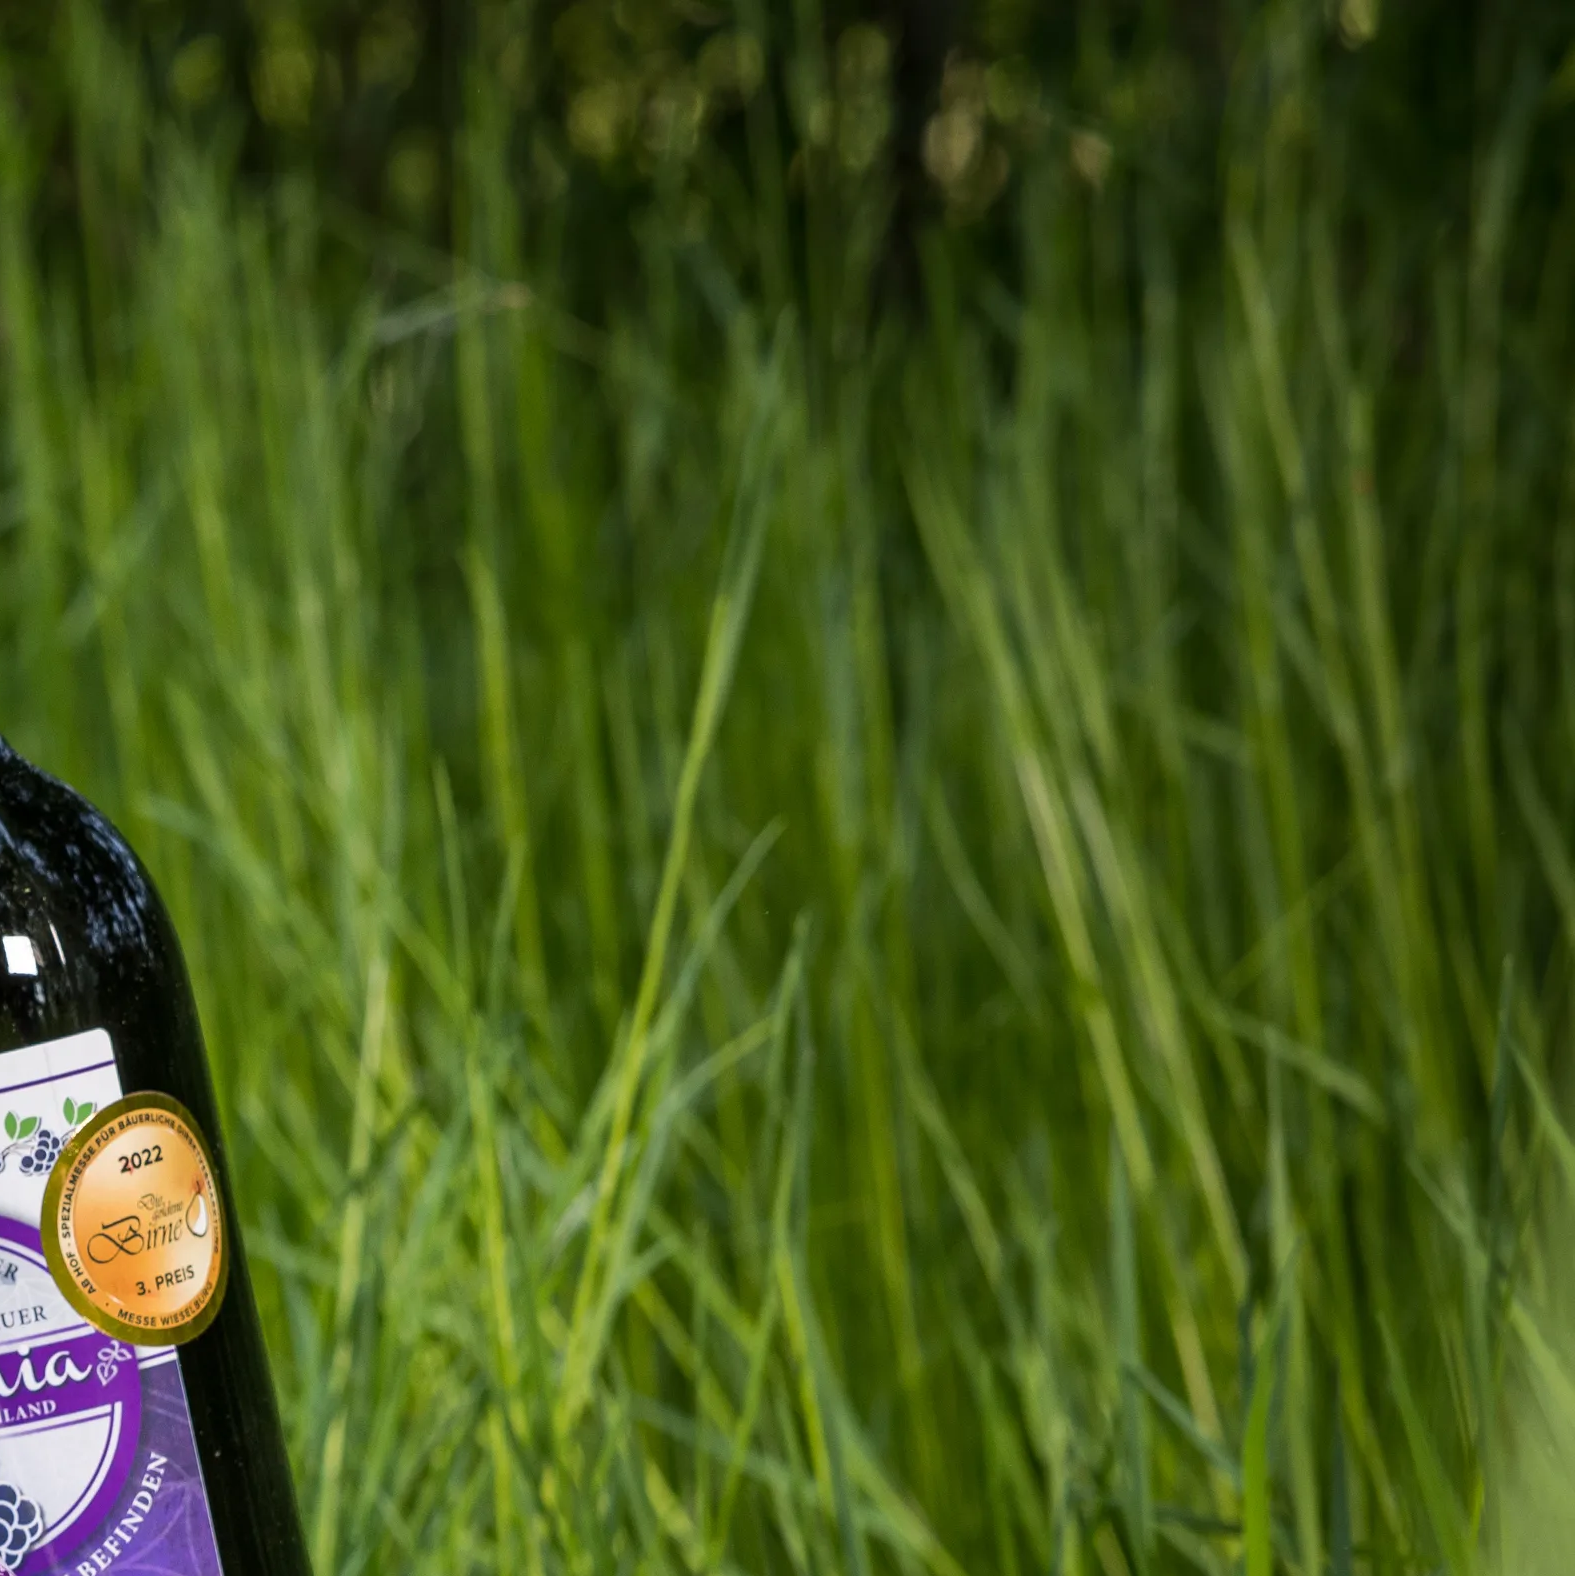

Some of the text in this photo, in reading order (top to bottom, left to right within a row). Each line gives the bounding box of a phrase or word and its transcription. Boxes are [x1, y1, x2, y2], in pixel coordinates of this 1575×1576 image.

[118, 1112, 176, 1130] BÄUERLICHE
[96, 1126, 117, 1148] FÜR
[118, 1145, 164, 1174] 2022
[61, 1146, 95, 1239] SPEZIALMESSE
[87, 1215, 183, 1264] Birne
[66, 1251, 85, 1278] HOF
[81, 1279, 97, 1295] AB
[136, 1265, 195, 1296] 3. PREIS
[117, 1282, 213, 1327] MESSE WIESELBURG
